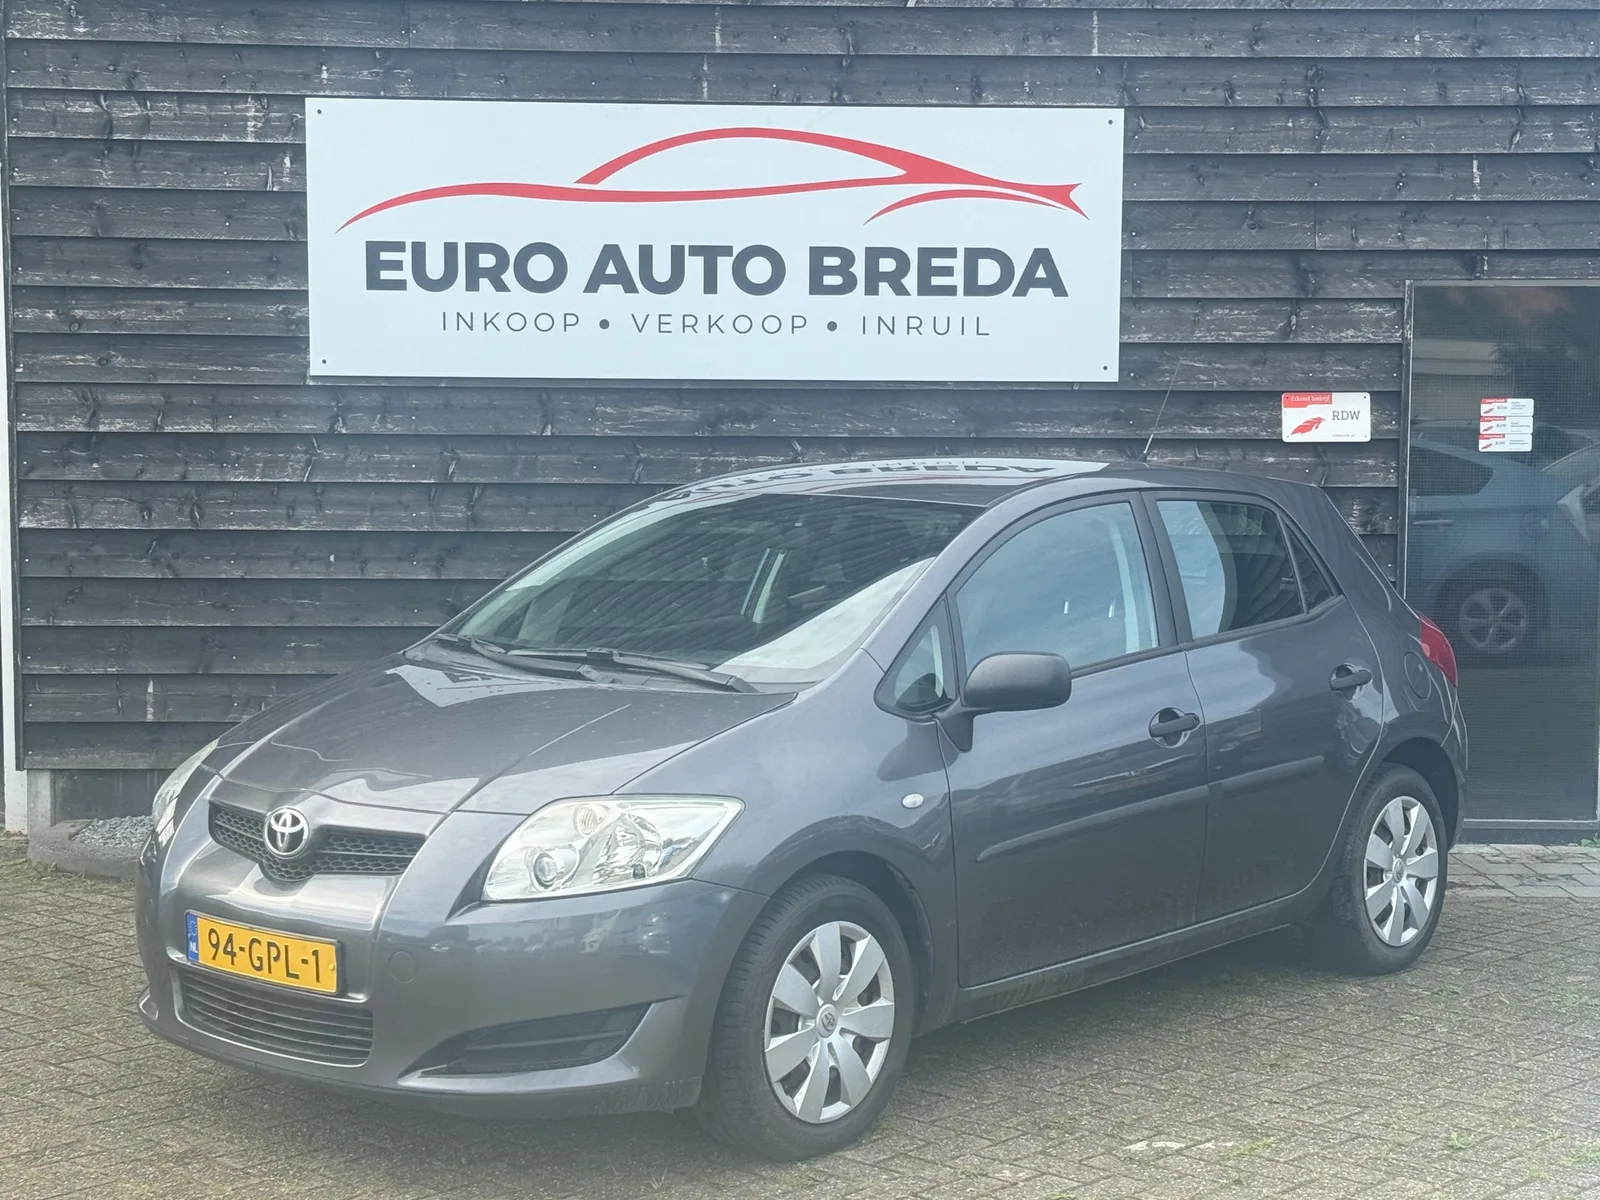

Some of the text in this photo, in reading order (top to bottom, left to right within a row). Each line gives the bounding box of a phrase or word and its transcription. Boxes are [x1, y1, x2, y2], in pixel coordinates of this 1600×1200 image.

[365, 240, 1069, 298] EURO AUTO BREDA
[442, 311, 990, 336] INKOOP VERKOOP INRUIL
[1332, 410, 1361, 421] RDW
[208, 927, 321, 983] 94-GPL-1
